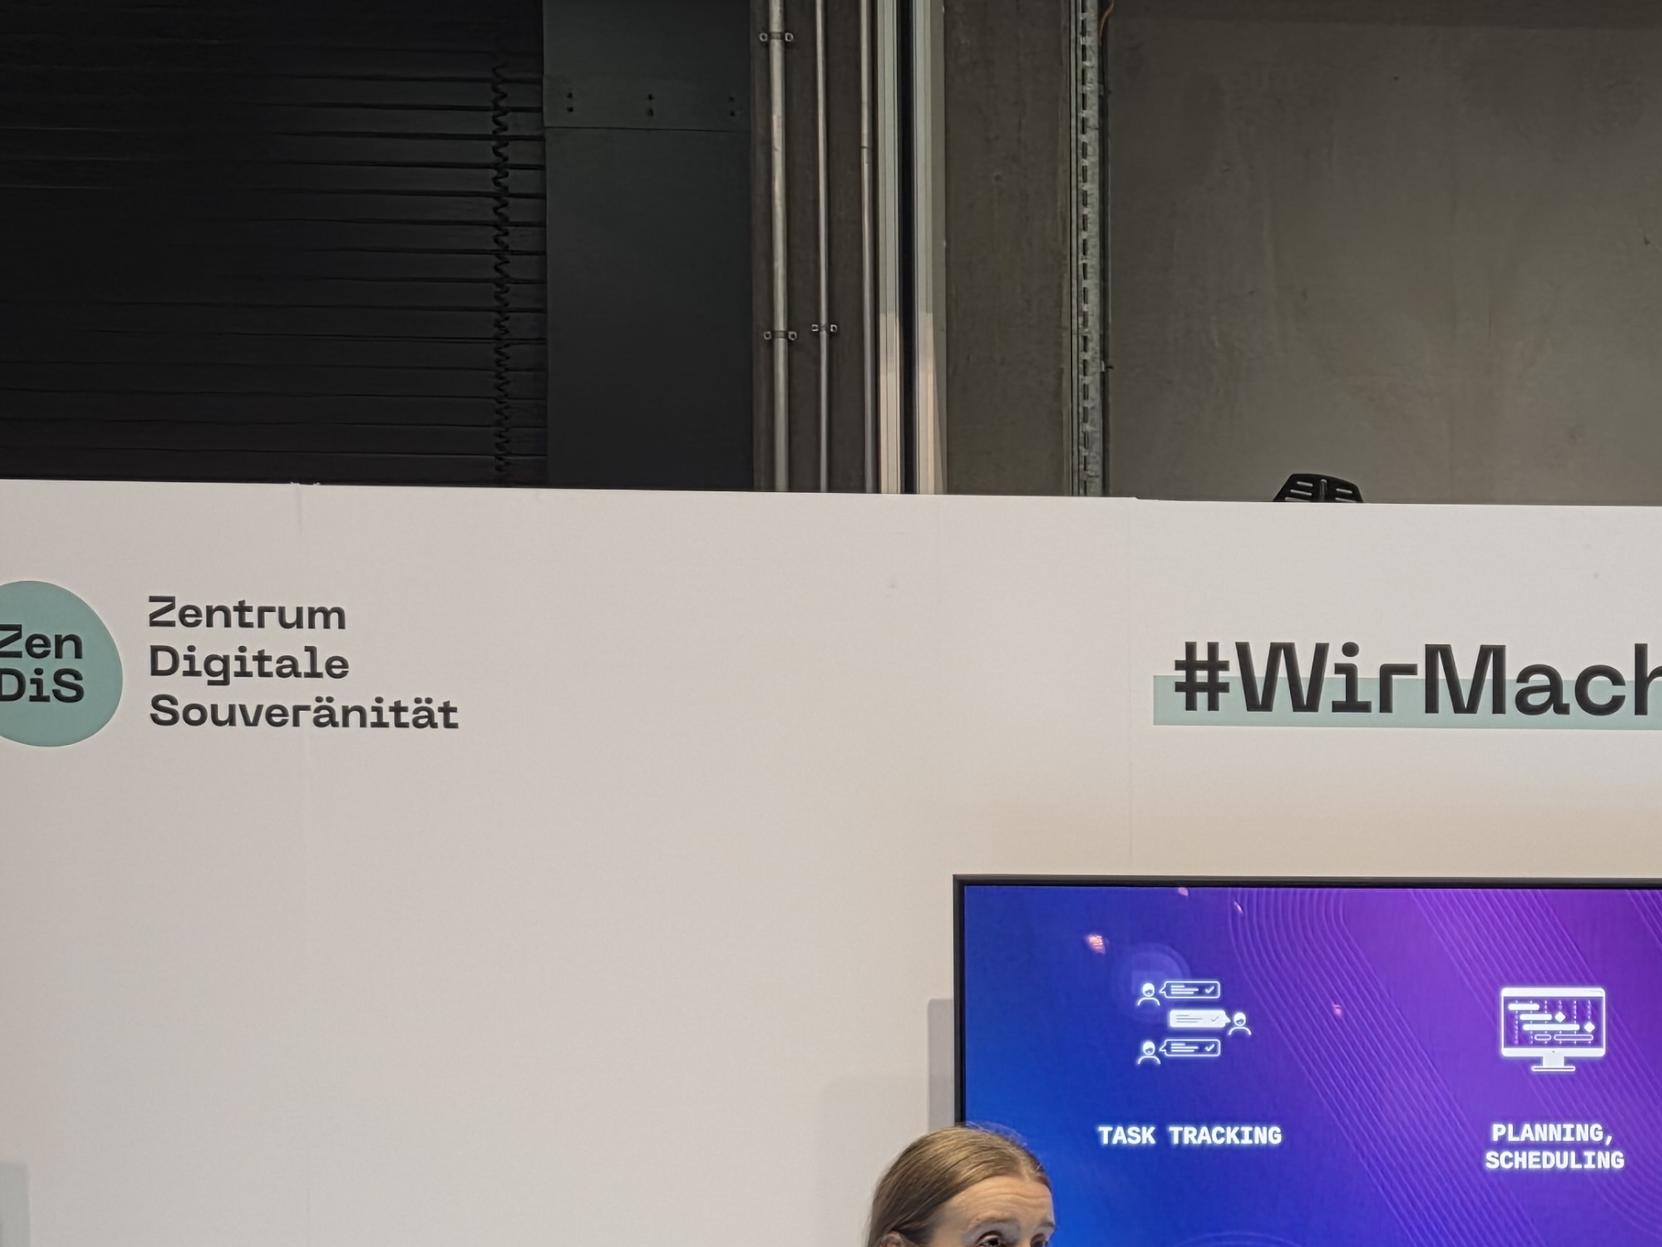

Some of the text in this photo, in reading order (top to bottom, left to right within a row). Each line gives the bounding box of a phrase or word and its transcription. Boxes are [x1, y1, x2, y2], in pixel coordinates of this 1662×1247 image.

[148, 595, 346, 630] Zentrum
[0, 623, 83, 660] Zen
[149, 644, 349, 687] Digitale
[0, 667, 85, 704] DiS
[149, 693, 459, 729] Souveränität
[1097, 1125, 1283, 1145] TASK TRACKING
[1491, 1123, 1613, 1146] PLANNING,
[1485, 1150, 1625, 1170] SCHEDULING
